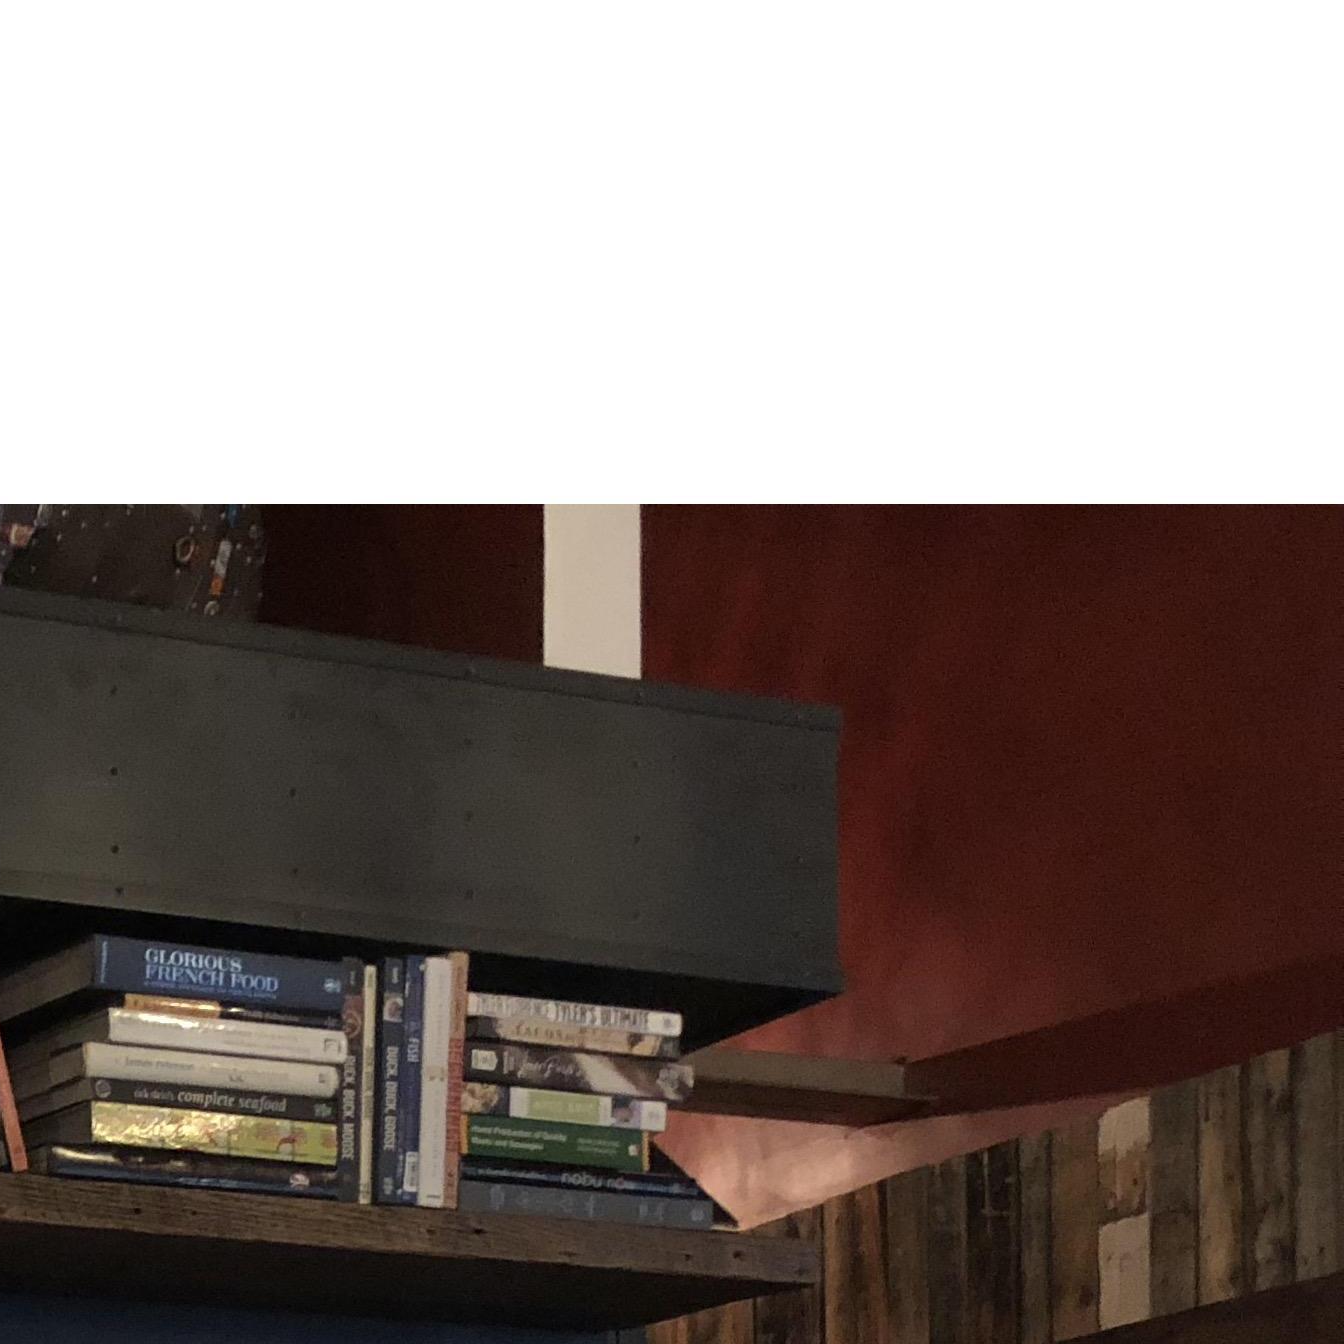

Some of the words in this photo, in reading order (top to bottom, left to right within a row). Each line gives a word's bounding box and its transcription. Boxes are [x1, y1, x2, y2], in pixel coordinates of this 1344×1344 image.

[145, 947, 242, 973] GLORIOUS
[145, 964, 225, 988] FRENCH
[230, 972, 280, 992] FOOD
[177, 1090, 236, 1108] complete
[238, 1094, 288, 1113] seafood
[384, 1115, 397, 1151] GOOSE
